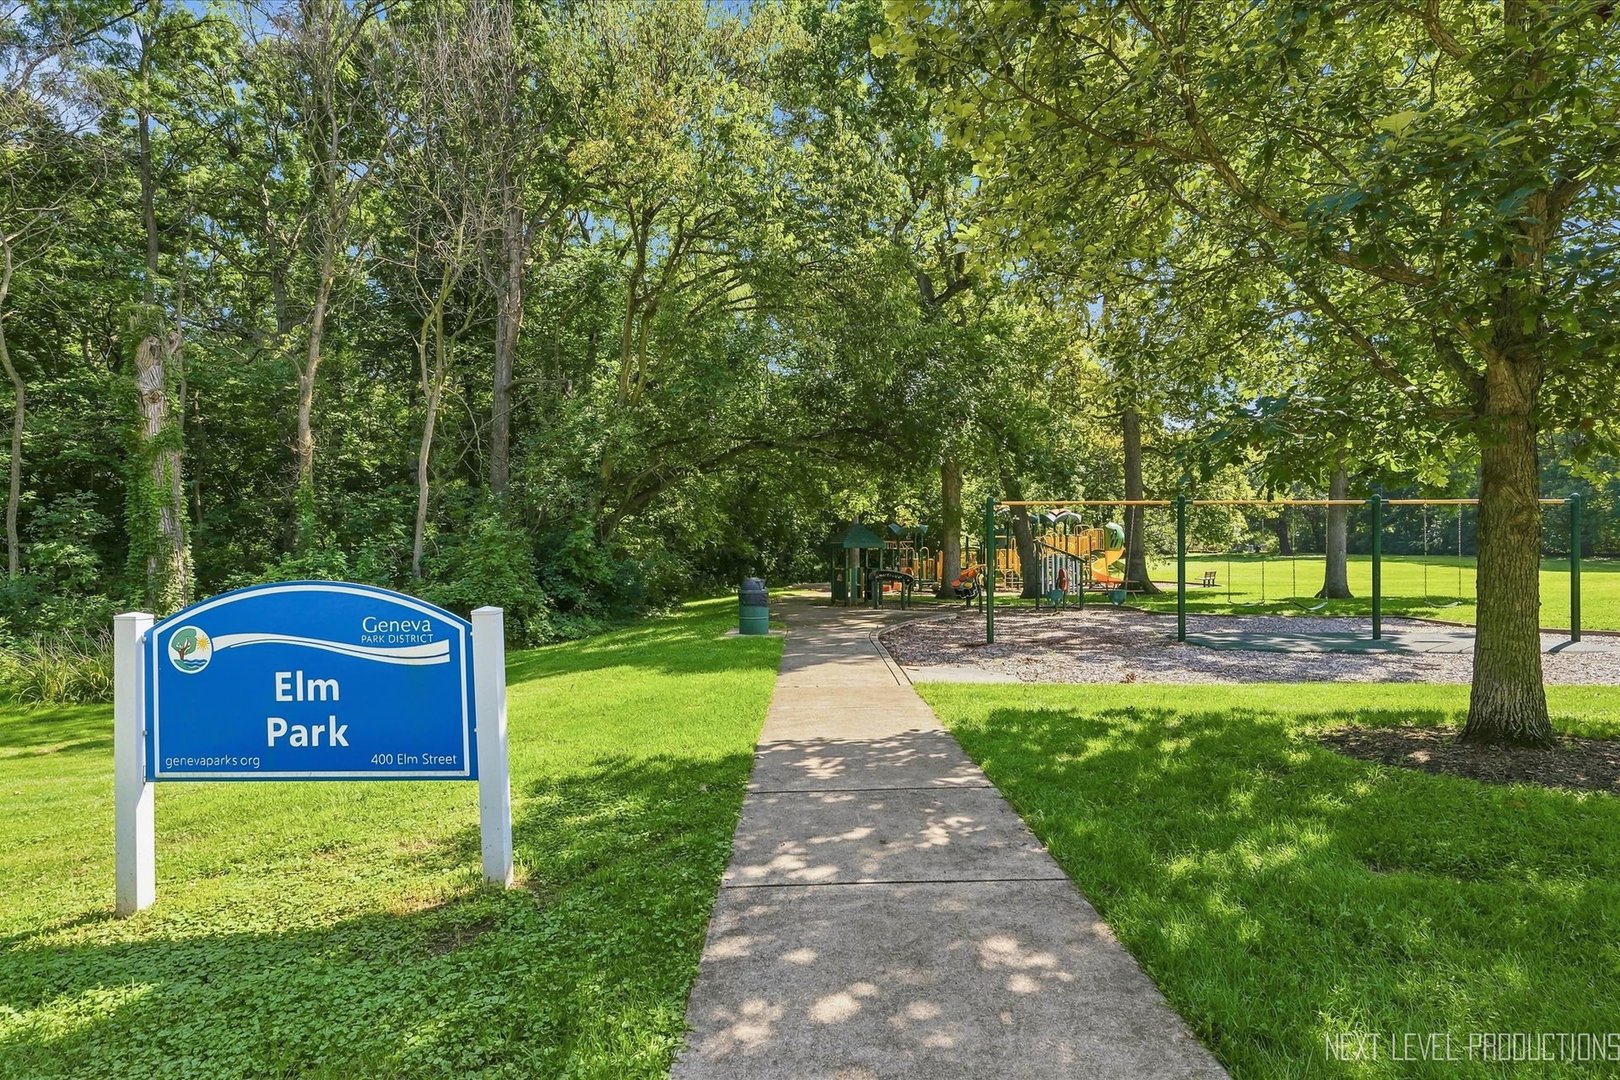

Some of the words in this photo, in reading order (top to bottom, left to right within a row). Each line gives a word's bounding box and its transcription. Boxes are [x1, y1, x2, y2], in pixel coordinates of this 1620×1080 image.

[362, 616, 432, 633] Geneva
[361, 634, 385, 643] PARK
[388, 633, 434, 643] DISTRICT
[275, 670, 340, 702] Elm
[266, 715, 349, 748] Park
[371, 753, 393, 765] 400
[397, 753, 418, 765] Elm
[422, 753, 457, 765] Street
